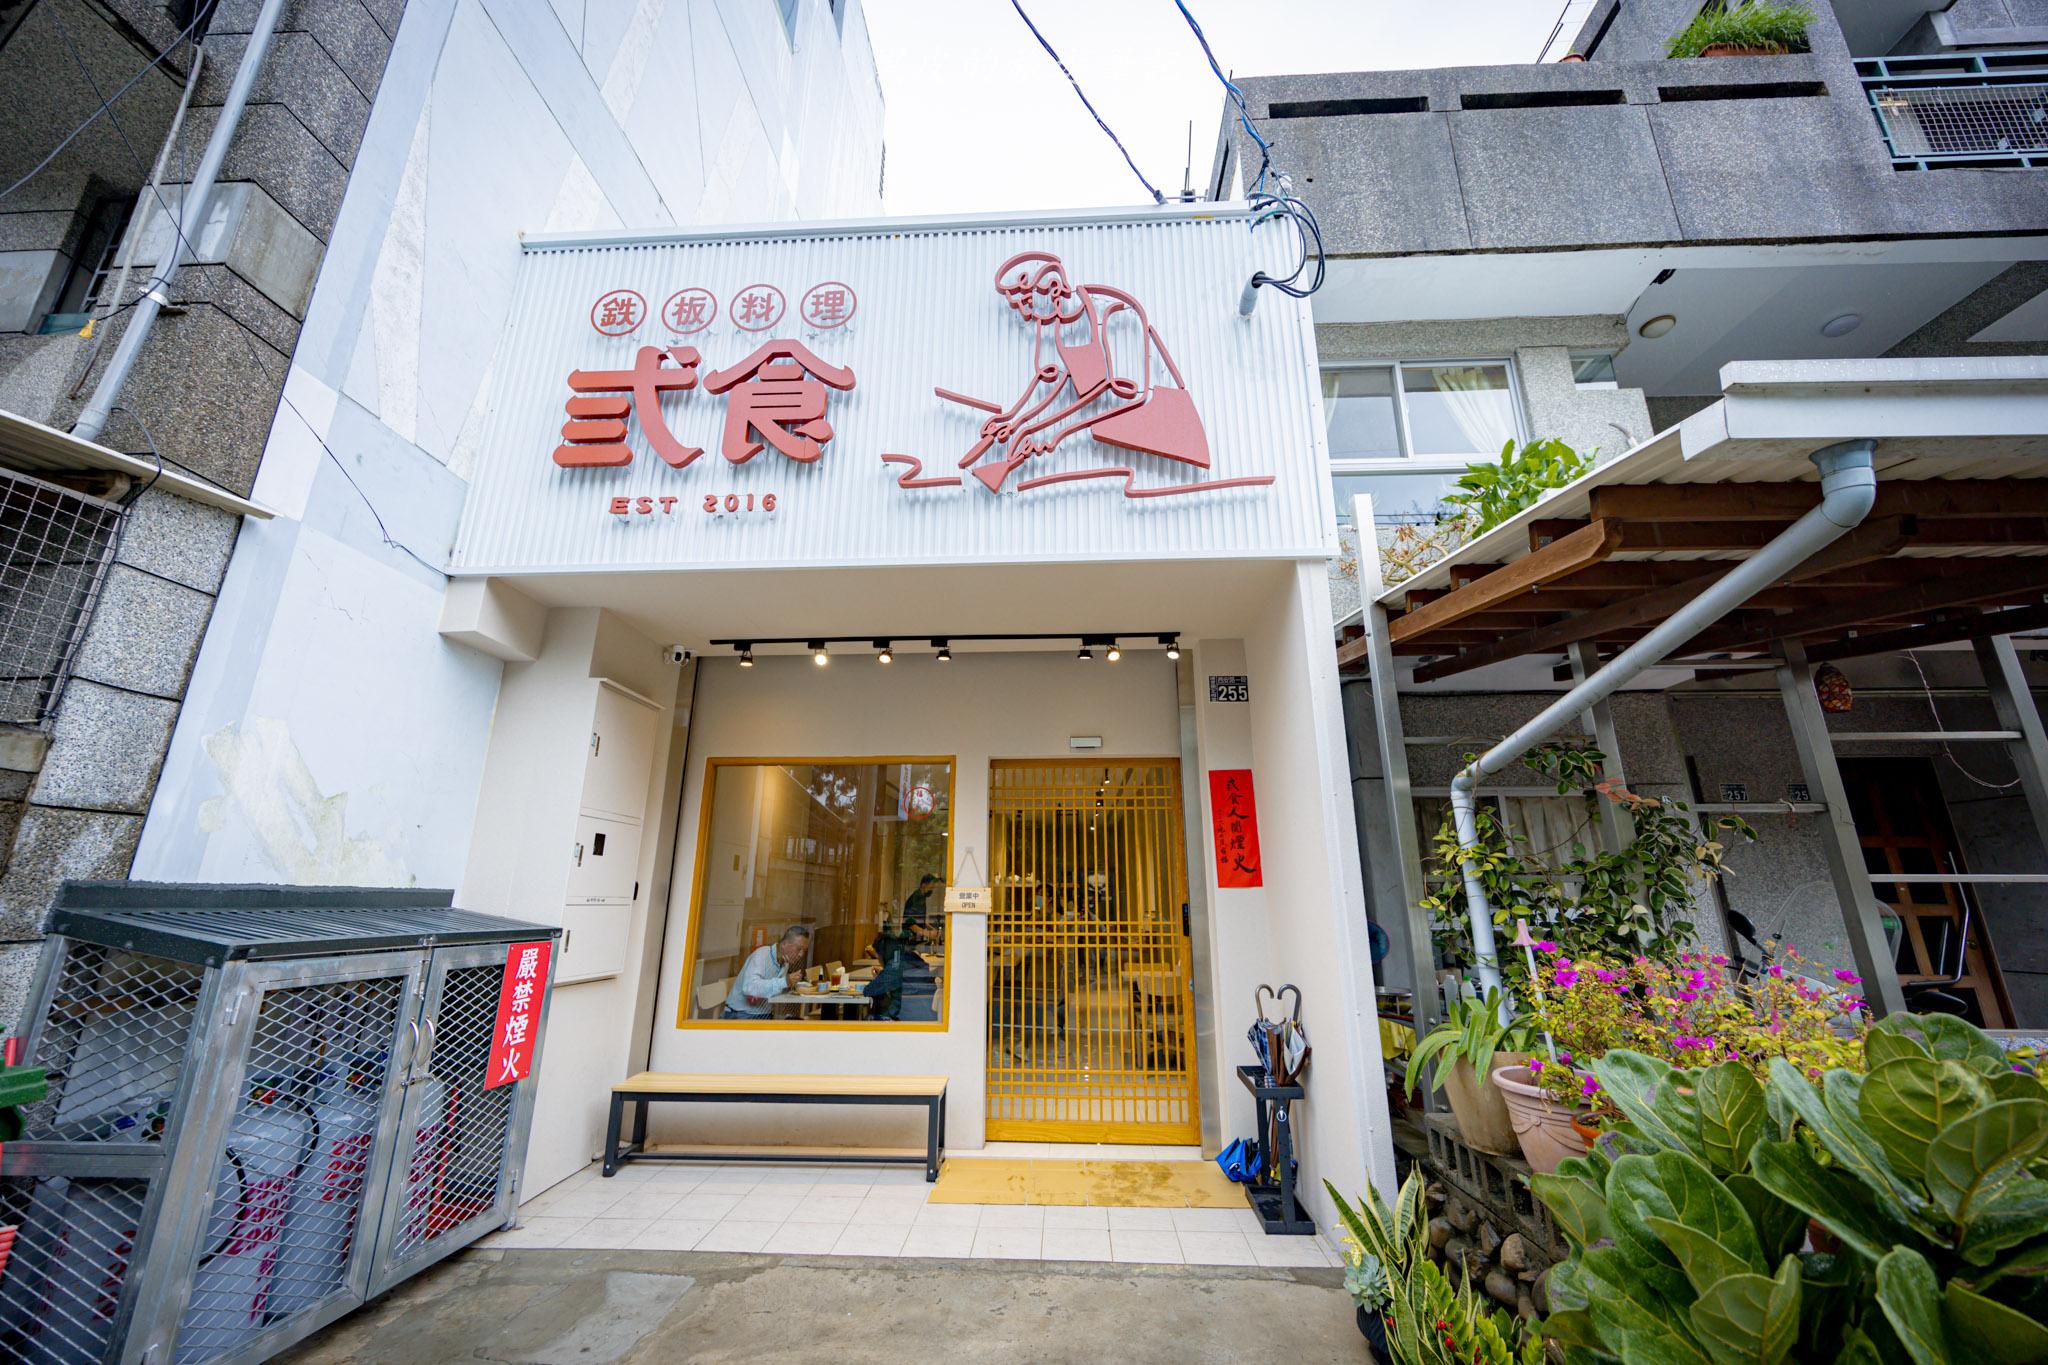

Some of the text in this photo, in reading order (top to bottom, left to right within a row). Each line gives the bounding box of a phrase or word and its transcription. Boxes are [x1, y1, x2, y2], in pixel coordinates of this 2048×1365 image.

[595, 285, 852, 332] 鉄板料理
[608, 493, 778, 515] EST 2016
[1218, 685, 1248, 701] 255
[1727, 790, 1747, 801] 257
[1795, 790, 1809, 801] 25
[961, 901, 976, 909] OPEN
[499, 947, 539, 1083] 嚴禁煙火
